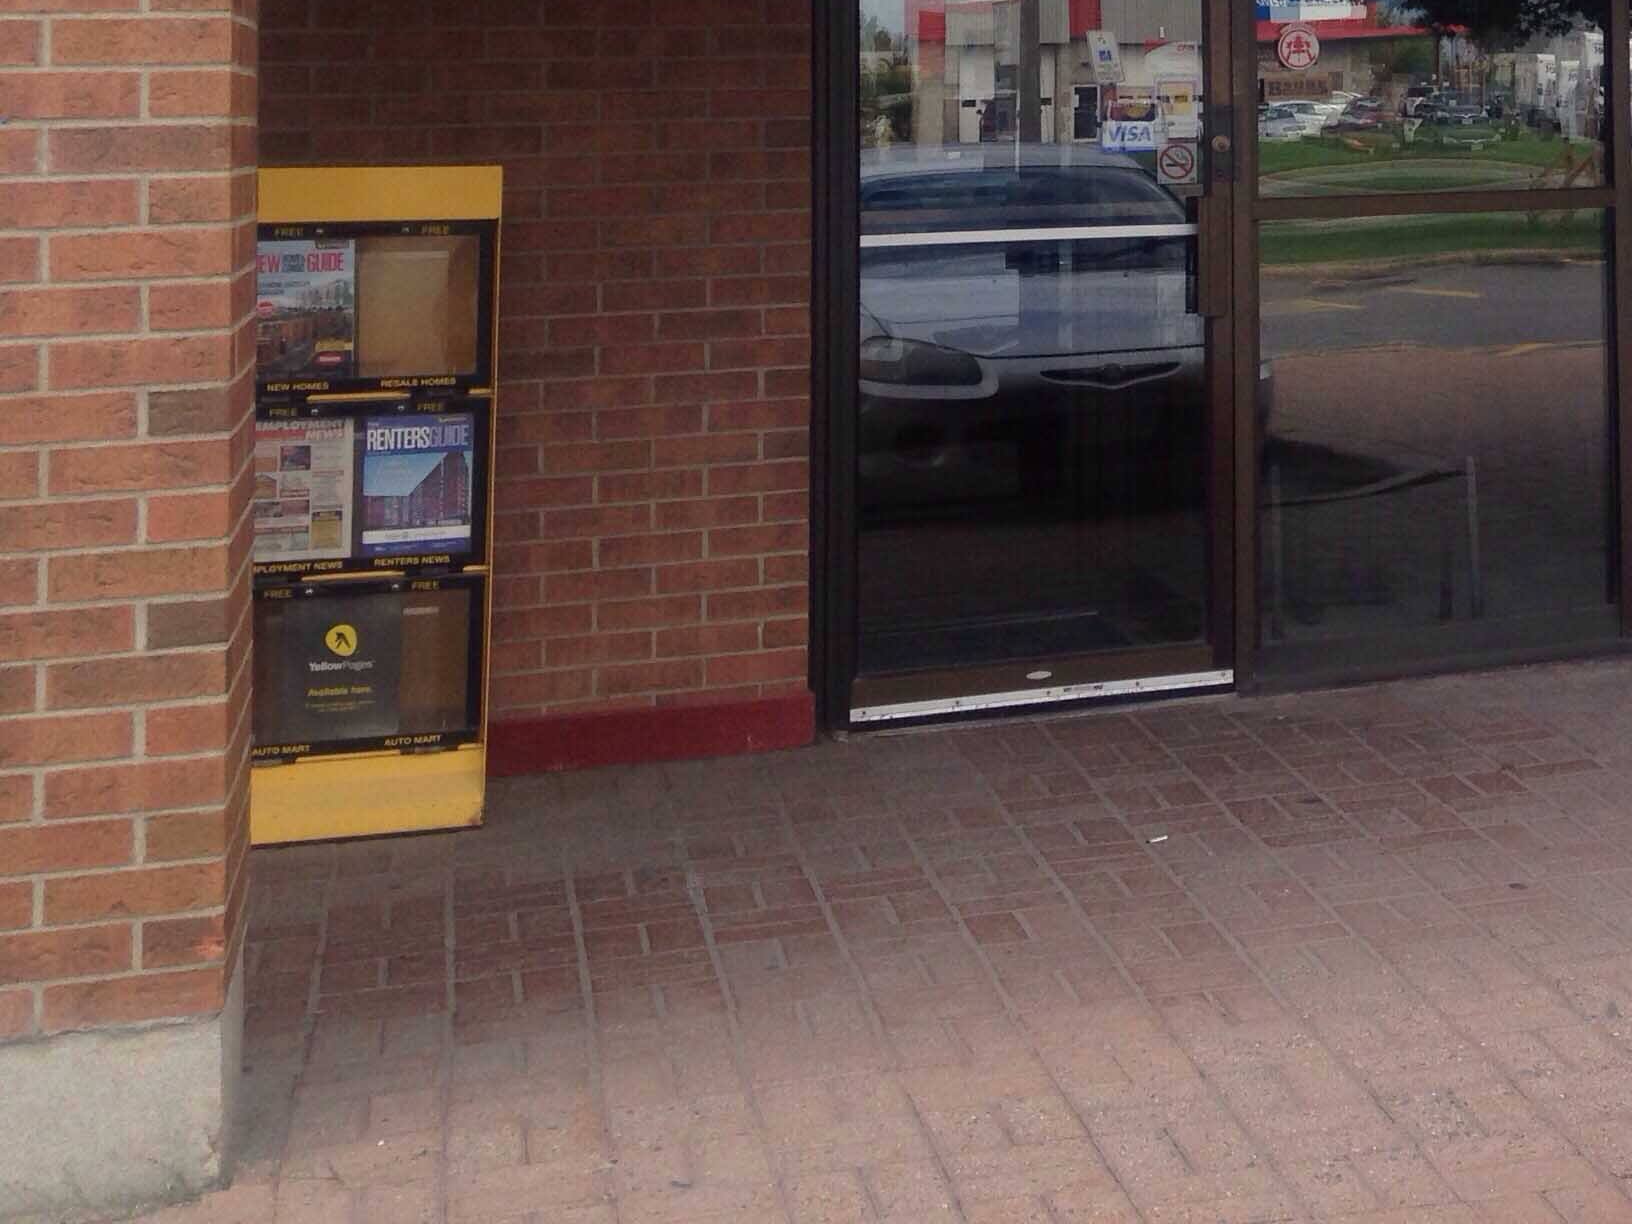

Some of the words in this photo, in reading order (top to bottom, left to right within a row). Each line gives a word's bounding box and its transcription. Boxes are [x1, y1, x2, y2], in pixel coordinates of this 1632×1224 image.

[1108, 123, 1151, 142] VISA
[256, 252, 281, 274] EW
[306, 251, 345, 274] GUIDE
[267, 382, 291, 393] NEW
[293, 380, 329, 392] HOMES
[421, 376, 456, 387] HOMES
[254, 563, 312, 574] PLOYMENT
[314, 560, 344, 571] NEWS
[374, 557, 419, 567] RENTERS
[421, 555, 450, 565] NEWS
[411, 580, 440, 591] FREE
[264, 589, 292, 599] FREE
[384, 737, 412, 748] AUTO
[414, 735, 442, 746] MART
[252, 747, 280, 757] AUTO
[282, 744, 311, 754] MART
